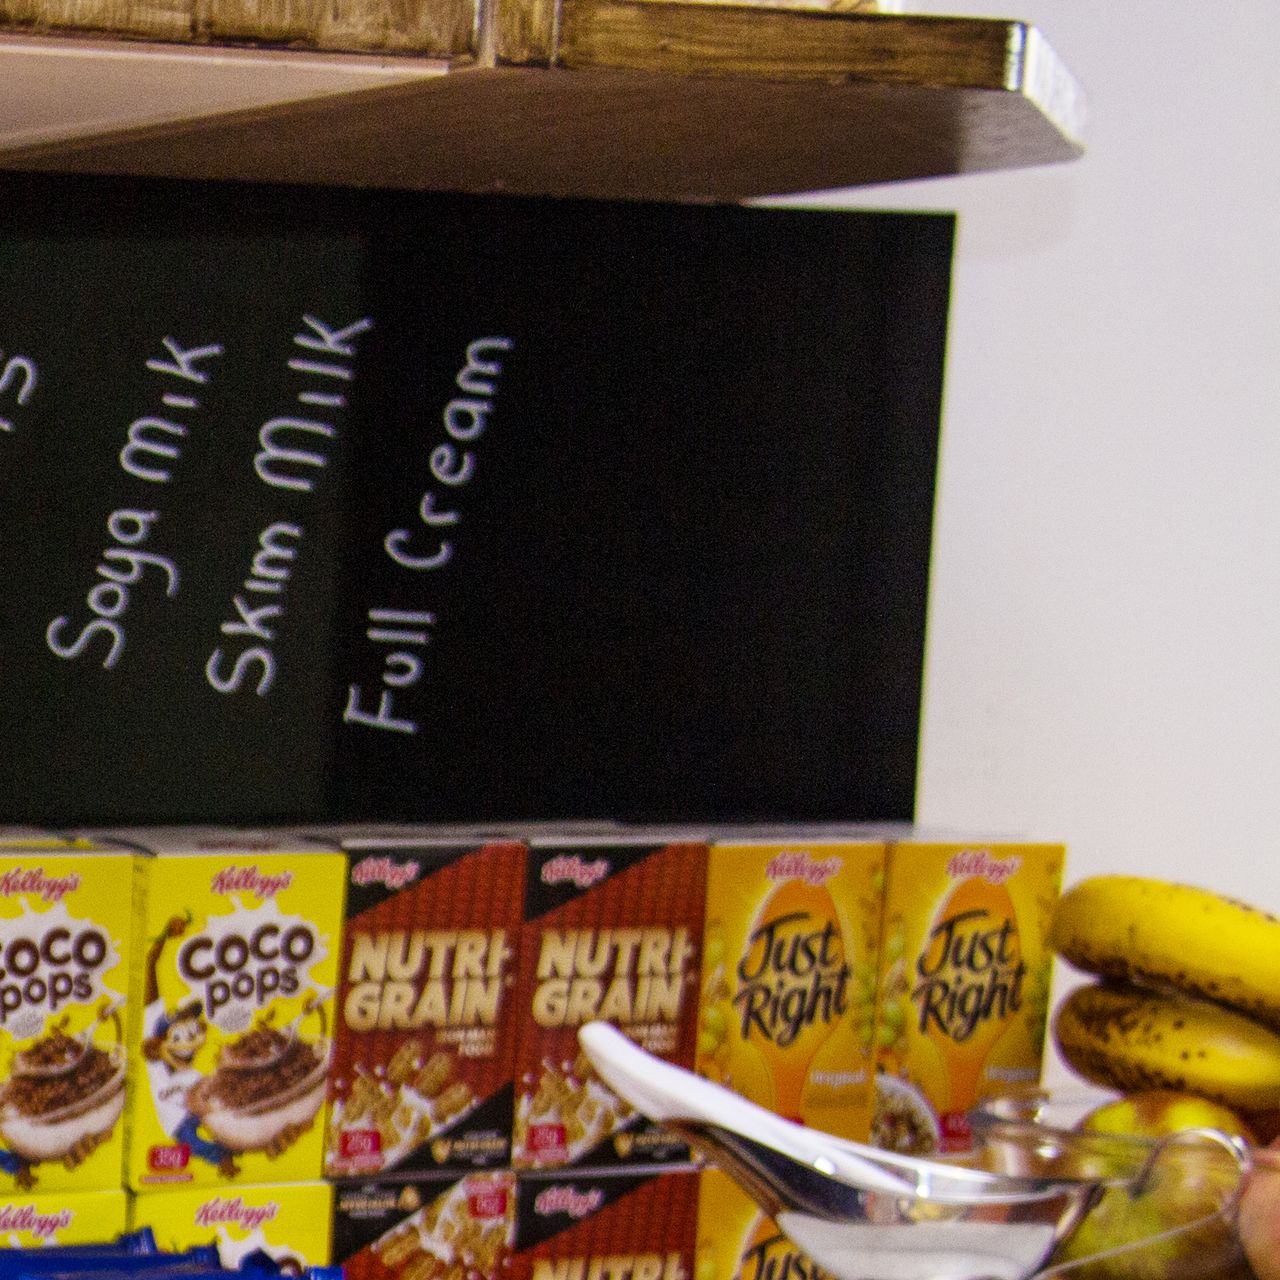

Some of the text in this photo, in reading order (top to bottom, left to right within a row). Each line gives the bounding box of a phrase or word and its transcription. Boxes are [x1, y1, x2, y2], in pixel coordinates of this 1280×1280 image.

[342, 334, 515, 733] Full Cream
[46, 507, 181, 670] Soya
[205, 521, 304, 697] Skim
[211, 864, 294, 897] Kellogg's
[737, 911, 844, 982] Just
[916, 908, 1018, 978] Just
[344, 979, 503, 1032] GRAIN
[532, 976, 684, 1028] GRAIN
[732, 965, 853, 1048] Right
[911, 960, 1028, 1044] Right
[195, 1196, 281, 1232] Kellogg's
